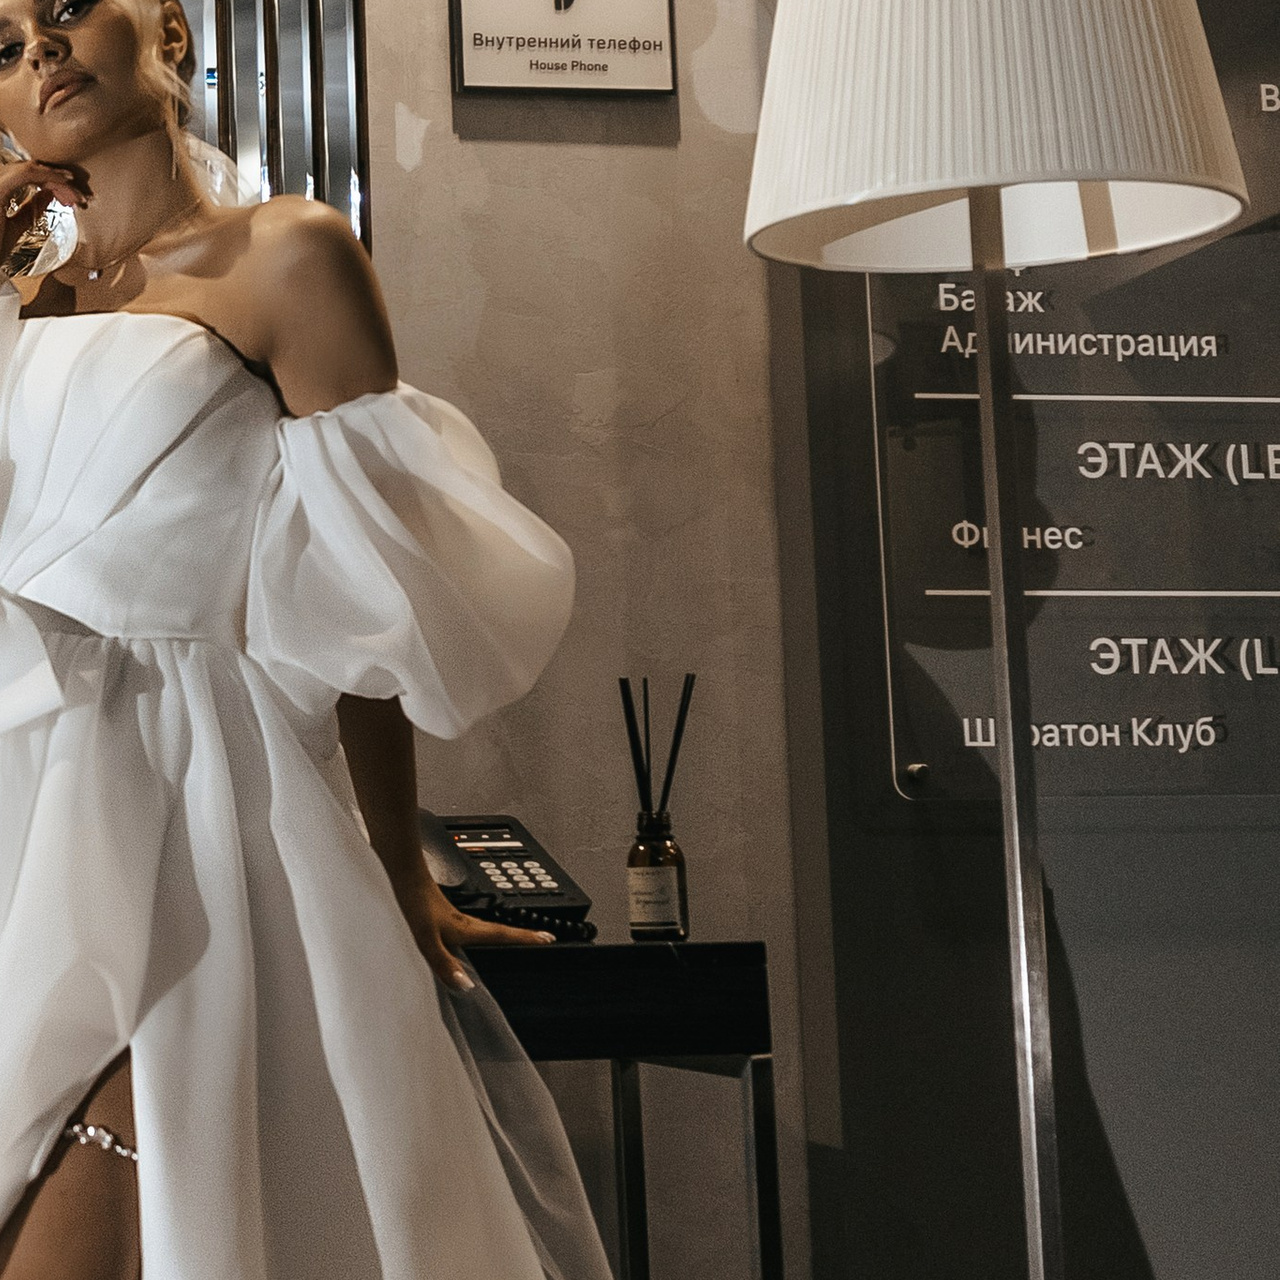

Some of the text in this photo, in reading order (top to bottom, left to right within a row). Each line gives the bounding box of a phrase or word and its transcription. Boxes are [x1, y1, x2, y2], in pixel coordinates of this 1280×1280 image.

[472, 32, 663, 55] Внутренний телефон
[529, 59, 609, 73] House Phone
[938, 283, 1045, 313] Бааж
[941, 325, 1218, 362] Адинистрация
[1077, 441, 1213, 479] ЭТАЖ
[952, 520, 1083, 550] Фнес
[1089, 637, 1280, 681] ЭТАЖ (L
[1131, 716, 1216, 754] Клуб
